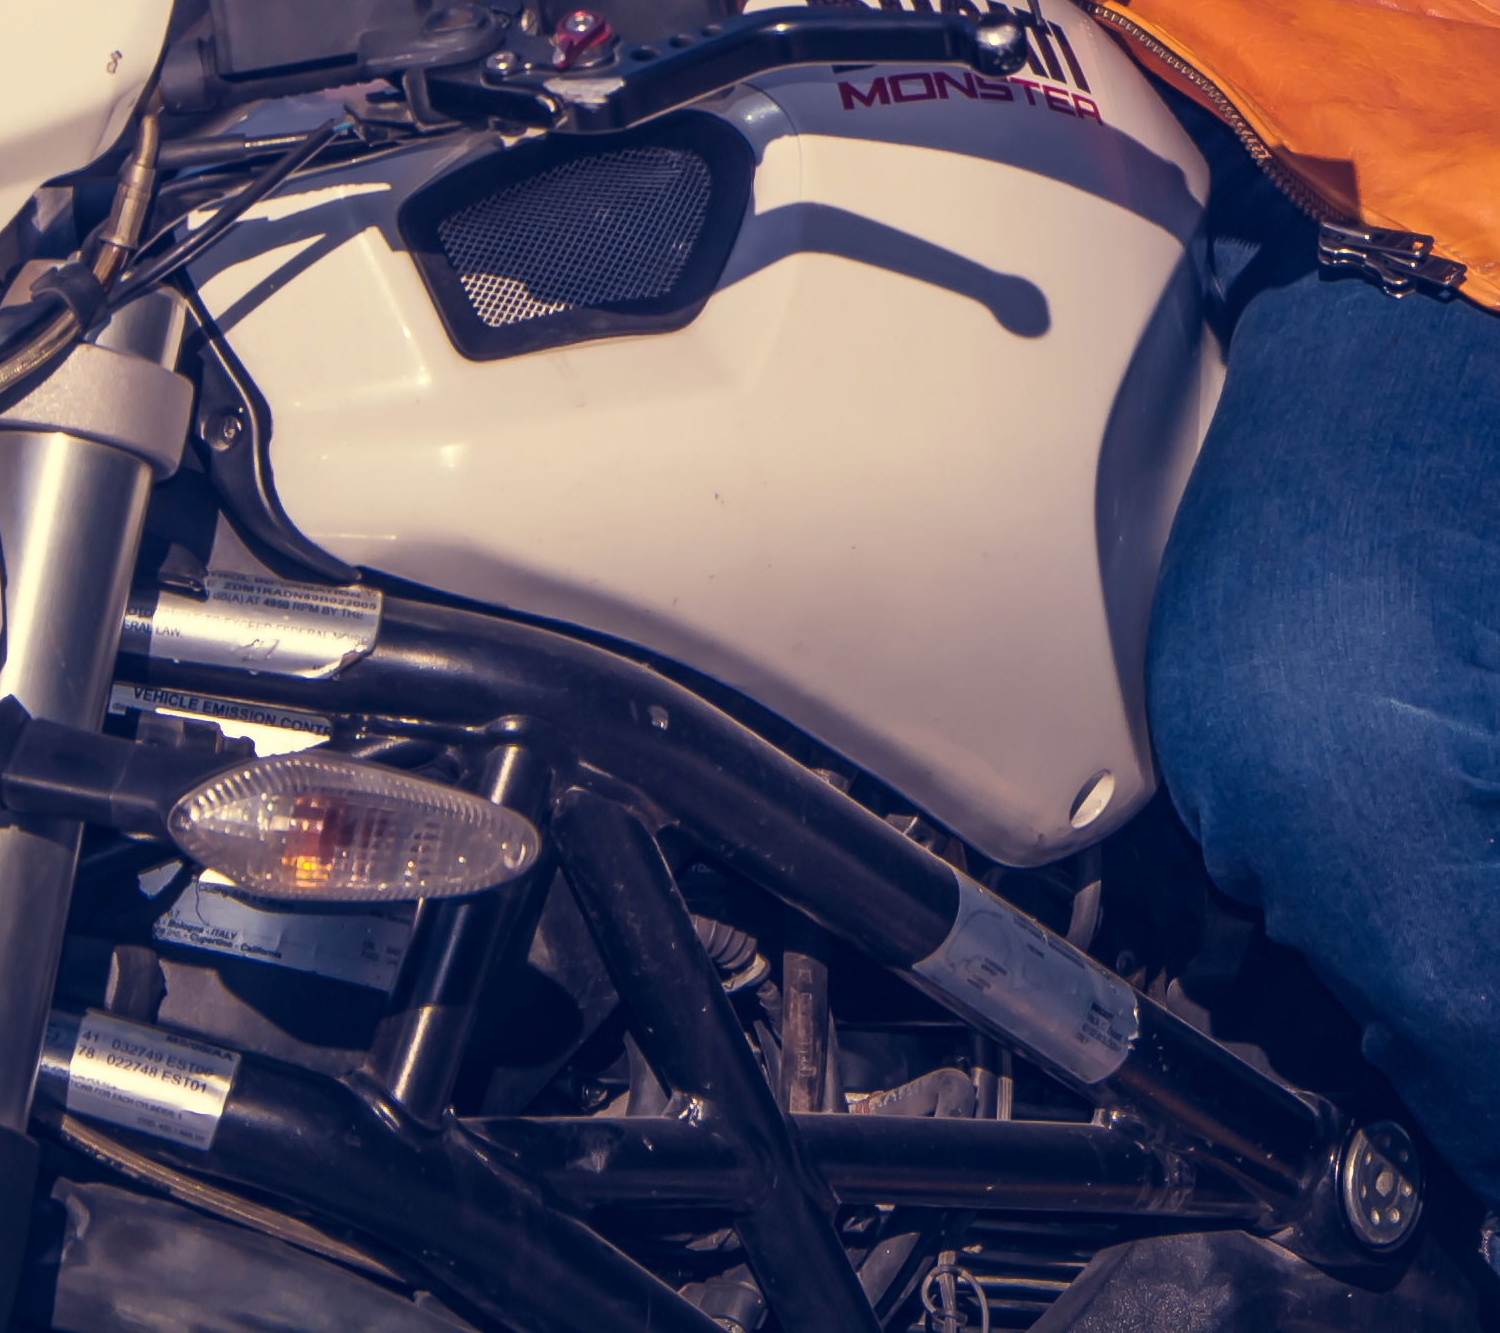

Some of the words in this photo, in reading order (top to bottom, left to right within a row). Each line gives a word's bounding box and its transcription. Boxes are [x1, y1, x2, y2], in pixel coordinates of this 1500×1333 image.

[836, 71, 1103, 126] MONSTER
[133, 686, 198, 710] VEHICLE
[202, 701, 277, 726] EMISSION
[210, 927, 238, 940] ITALY
